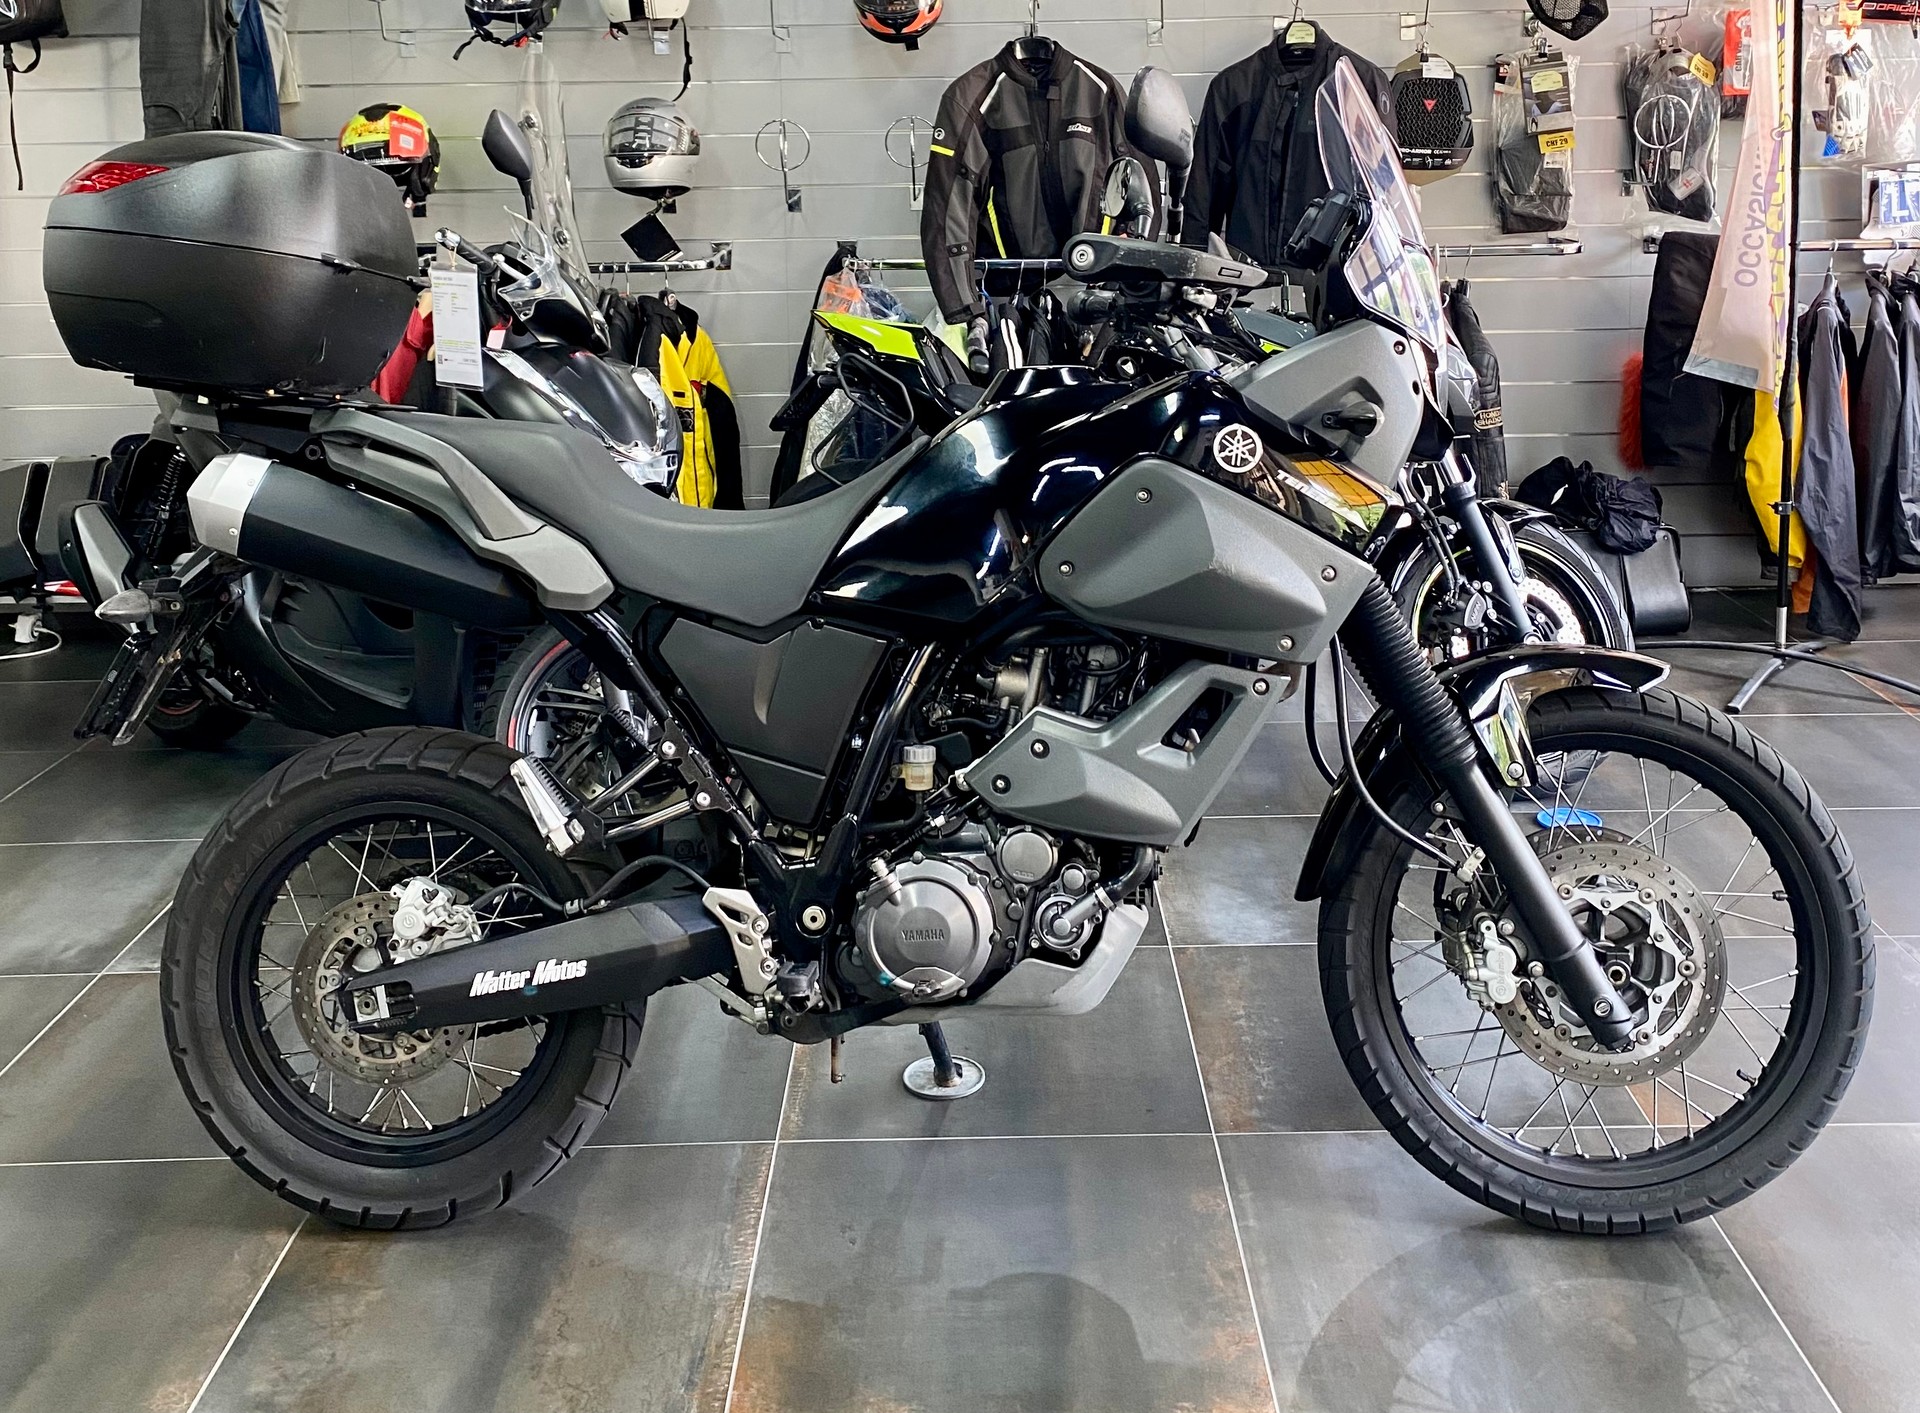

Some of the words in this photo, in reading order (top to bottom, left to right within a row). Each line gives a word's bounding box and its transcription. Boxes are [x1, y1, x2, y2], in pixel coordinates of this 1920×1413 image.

[902, 929, 945, 942] YAMAHA
[469, 969, 531, 997] Matter
[531, 958, 588, 986] Motos
